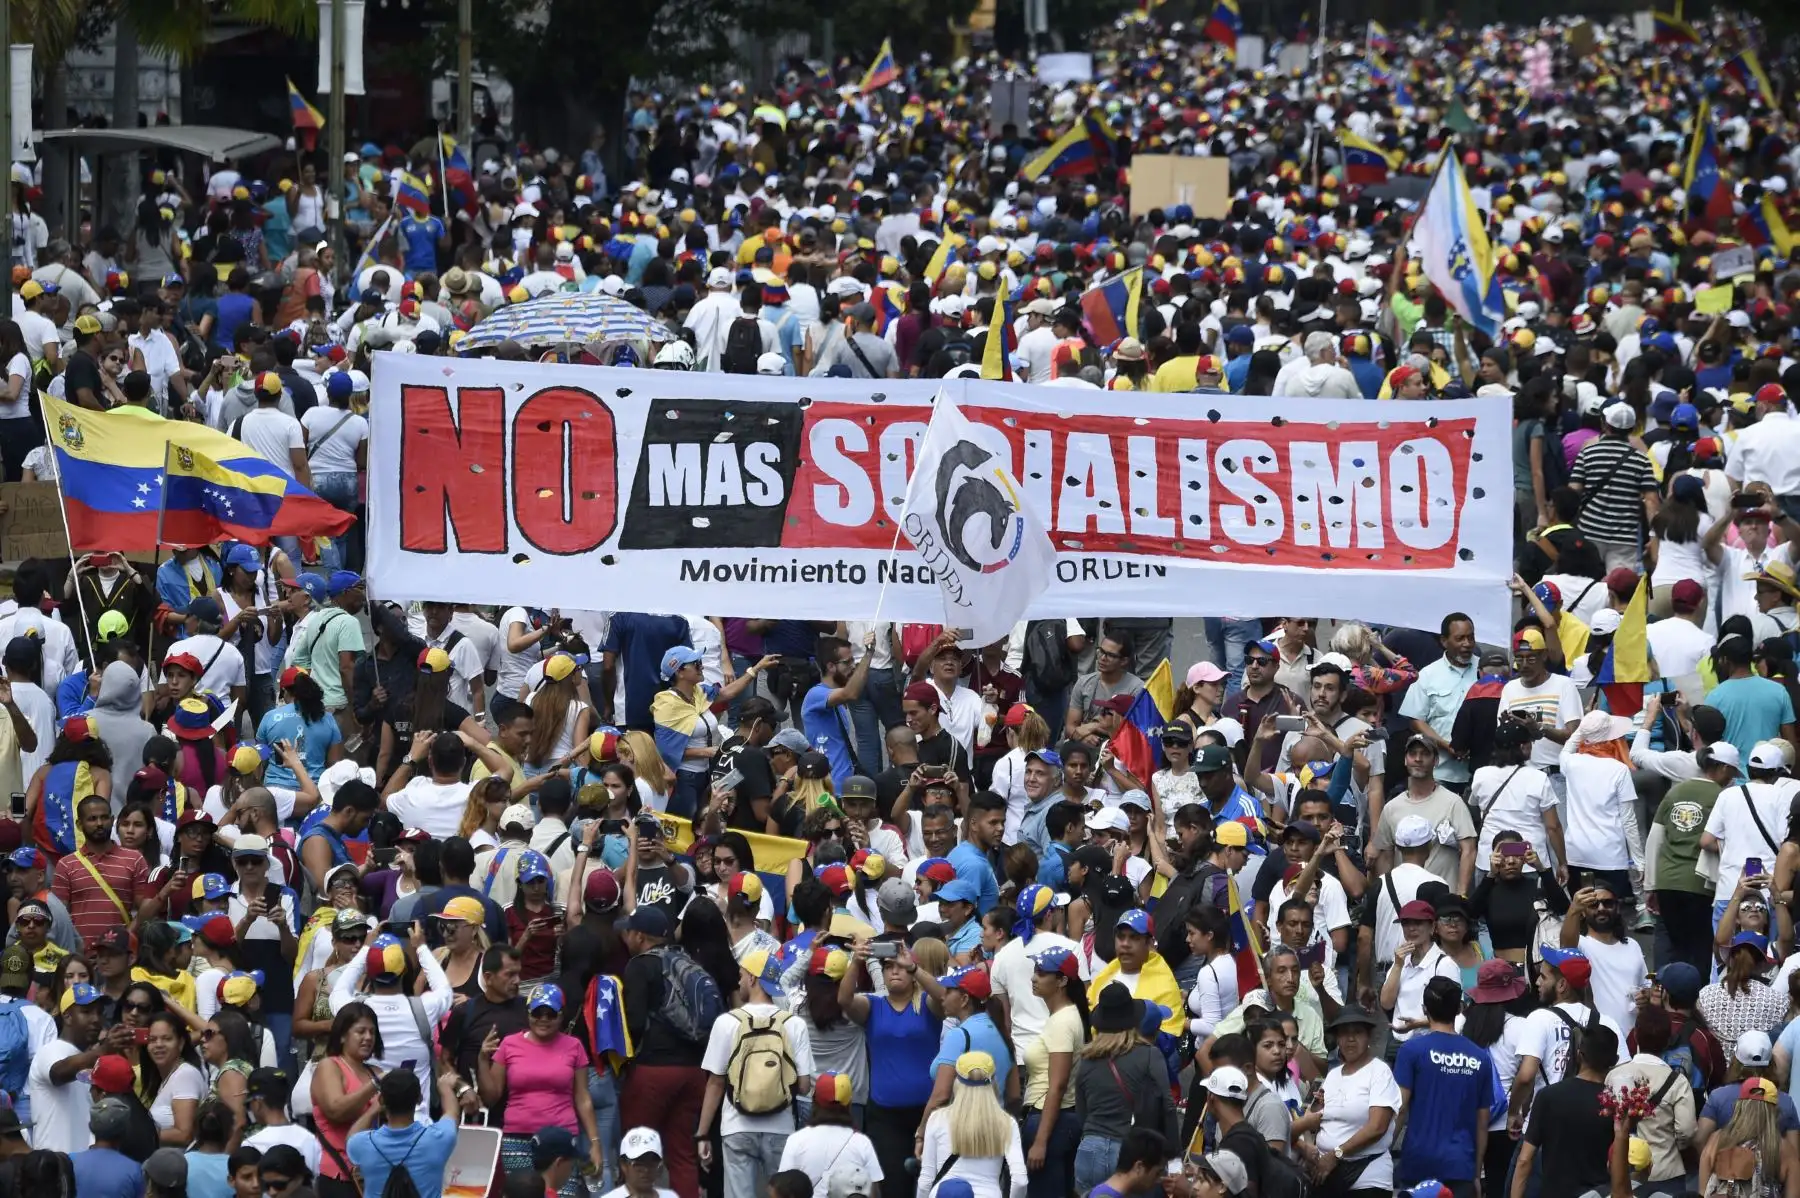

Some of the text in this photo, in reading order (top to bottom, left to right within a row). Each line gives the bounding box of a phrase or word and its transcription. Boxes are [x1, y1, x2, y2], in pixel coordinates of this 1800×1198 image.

[400, 383, 1454, 556] NO MÁS SOIALISMO
[679, 556, 867, 585] Movimiento
[877, 559, 936, 585] Naci
[905, 512, 973, 607] ORDEN
[1429, 1049, 1482, 1071] brother
